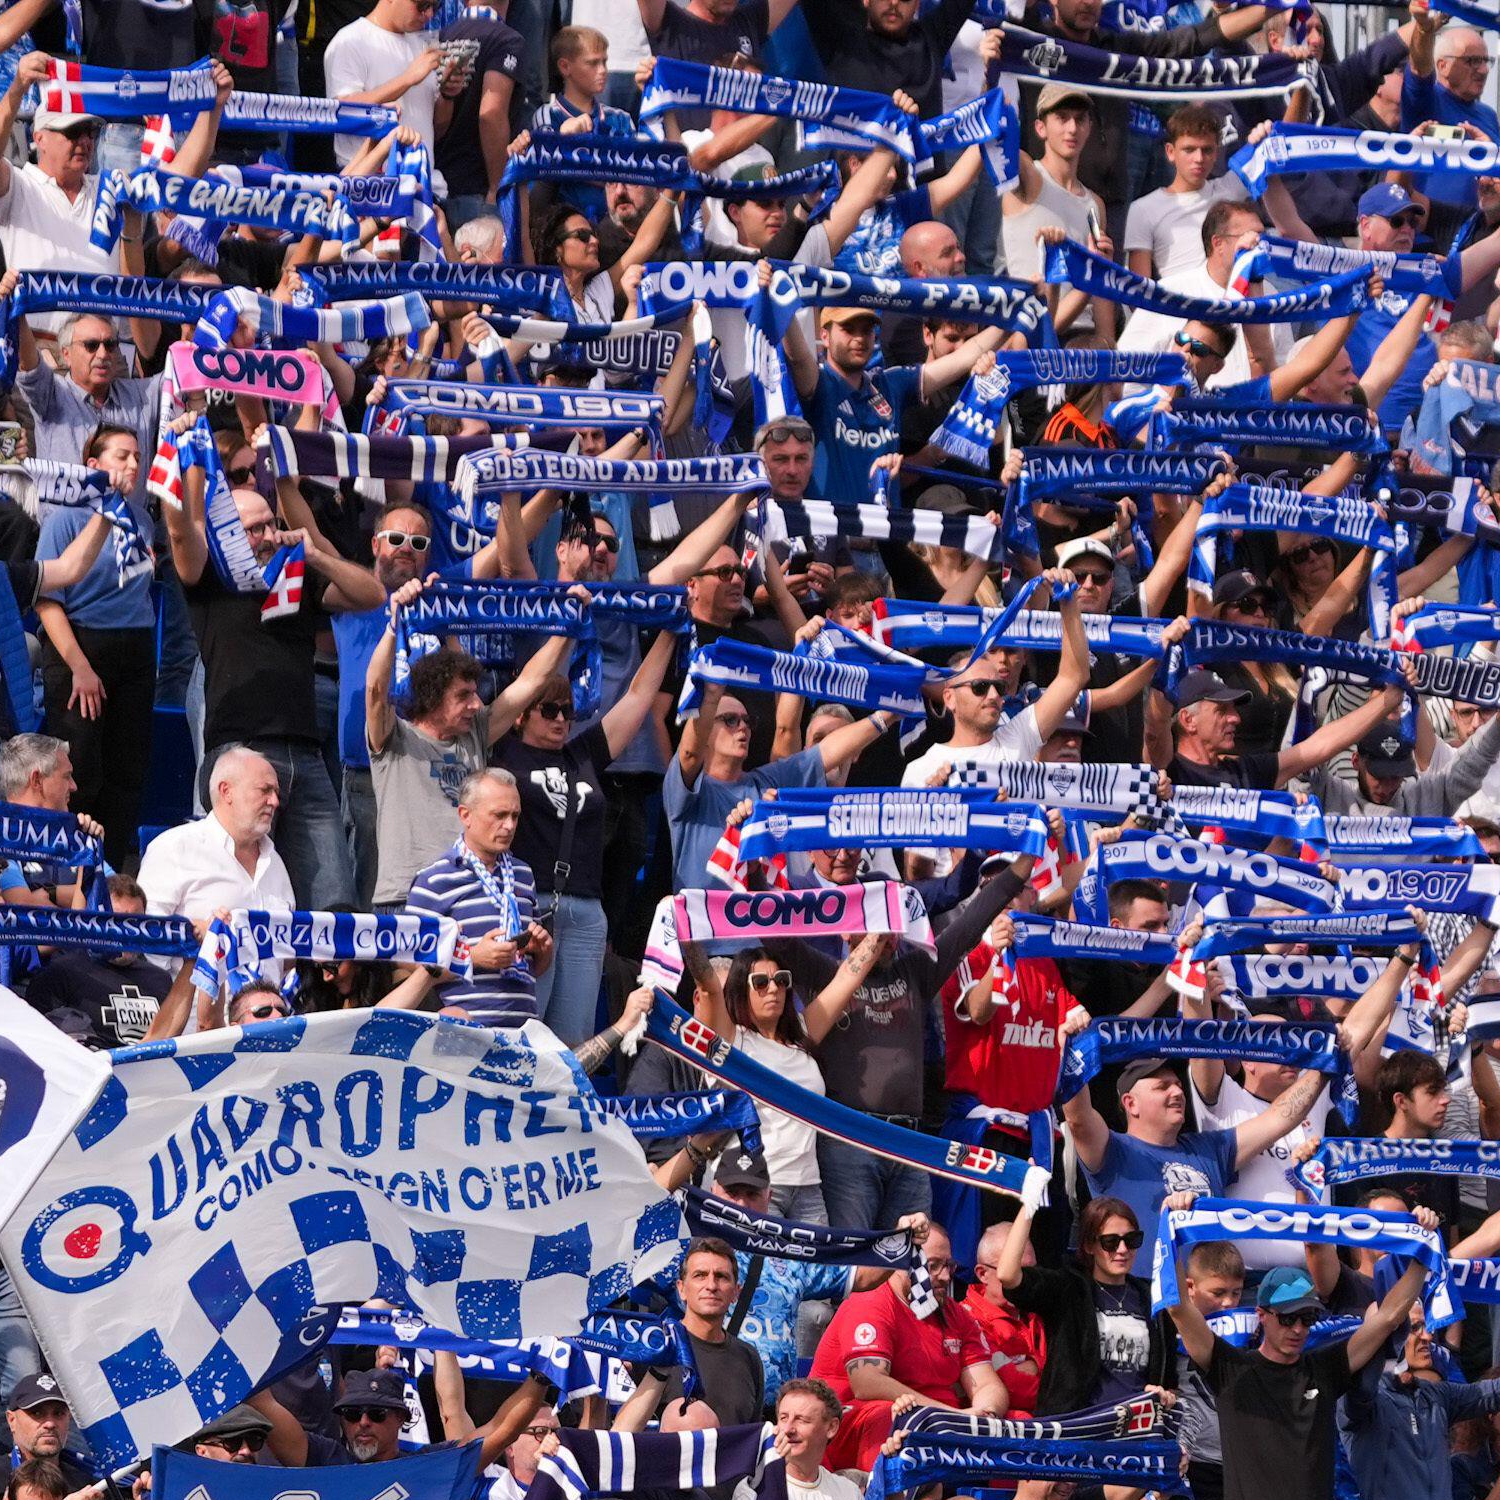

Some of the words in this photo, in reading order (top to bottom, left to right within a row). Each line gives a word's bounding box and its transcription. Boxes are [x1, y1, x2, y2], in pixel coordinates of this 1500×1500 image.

[1105, 52, 1259, 86] LARIANI
[1305, 138, 1338, 150] 1907
[1356, 131, 1498, 169] COMO
[189, 183, 286, 223] GALENA
[342, 176, 396, 202] 1907
[311, 262, 396, 287] SEMM
[407, 262, 560, 298] CUMASCH
[770, 267, 852, 303] OLD
[926, 281, 1046, 332] FANS
[193, 348, 305, 391] COMO
[1032, 350, 1098, 378] COMO
[396, 386, 546, 413] COMO
[480, 456, 613, 481] SOSTEGNO
[622, 459, 658, 481] AD
[827, 803, 881, 836] SEMM
[881, 800, 968, 838] CUMASCH
[1145, 835, 1278, 887] COMO
[1389, 870, 1467, 902] 1907
[28, 907, 187, 940] CUMASCH
[725, 889, 845, 928] COMO
[236, 924, 335, 948] FORZA
[357, 927, 439, 953] COMO
[1256, 957, 1374, 991] COMO
[1003, 1022, 1056, 1048] mita
[1100, 1021, 1184, 1046] SEMM
[1327, 1141, 1453, 1164] MAGICO
[21, 1066, 610, 1293] QUADROPHEN
[556, 1148, 602, 1200] ME
[1218, 1207, 1382, 1239] COMO
[747, 1236, 817, 1257] MAMBO
[902, 1446, 996, 1468] SEMM
